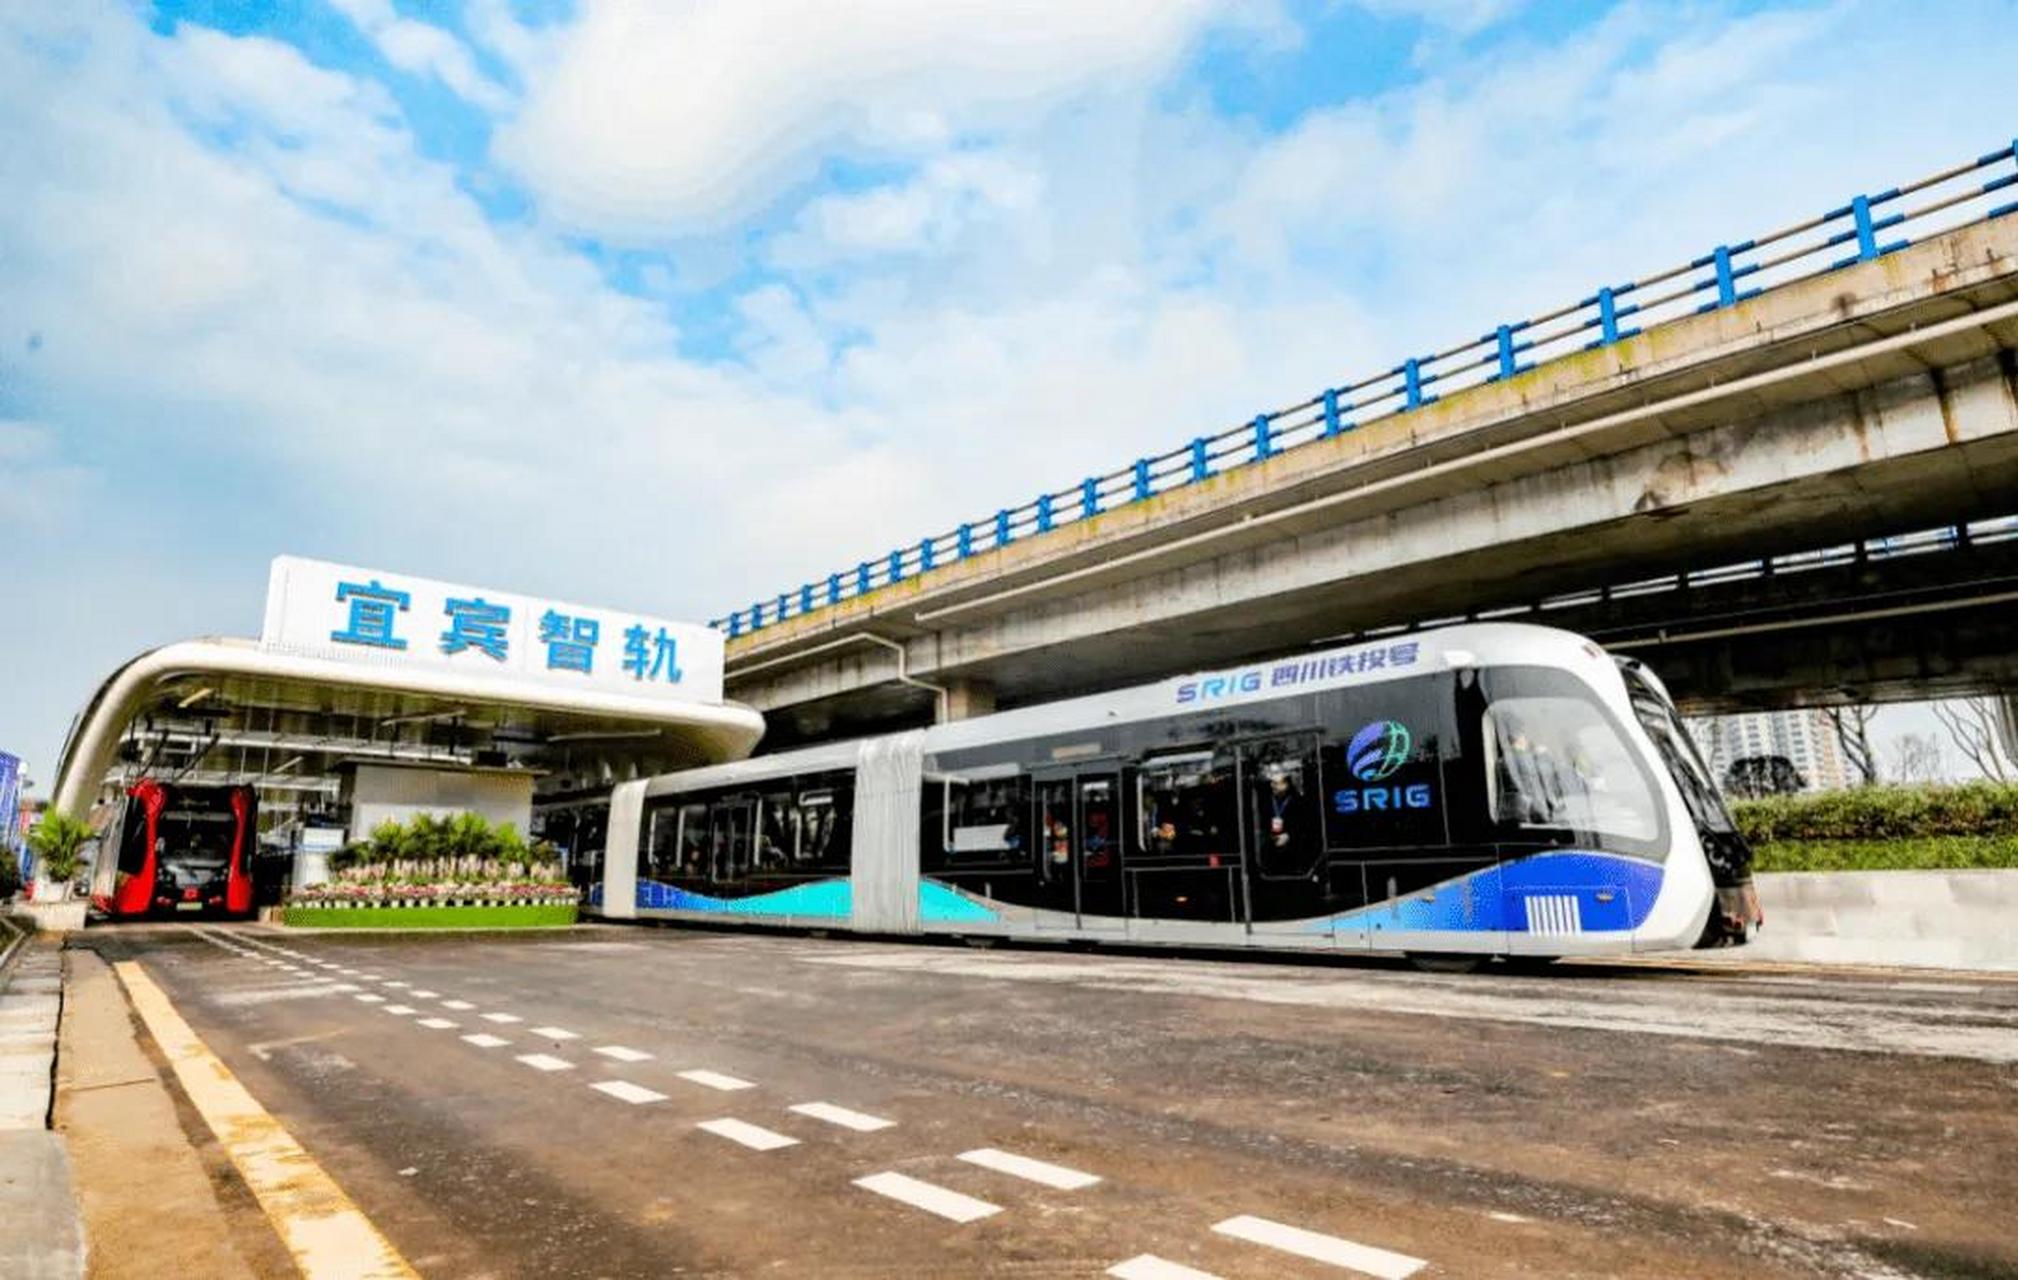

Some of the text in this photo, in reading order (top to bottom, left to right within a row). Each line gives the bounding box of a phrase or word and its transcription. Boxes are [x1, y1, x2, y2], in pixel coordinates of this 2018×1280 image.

[330, 580, 683, 684] 宜宾智轨
[1176, 642, 1419, 704] SRIG 四川铁投号
[1334, 784, 1431, 813] SRIG
